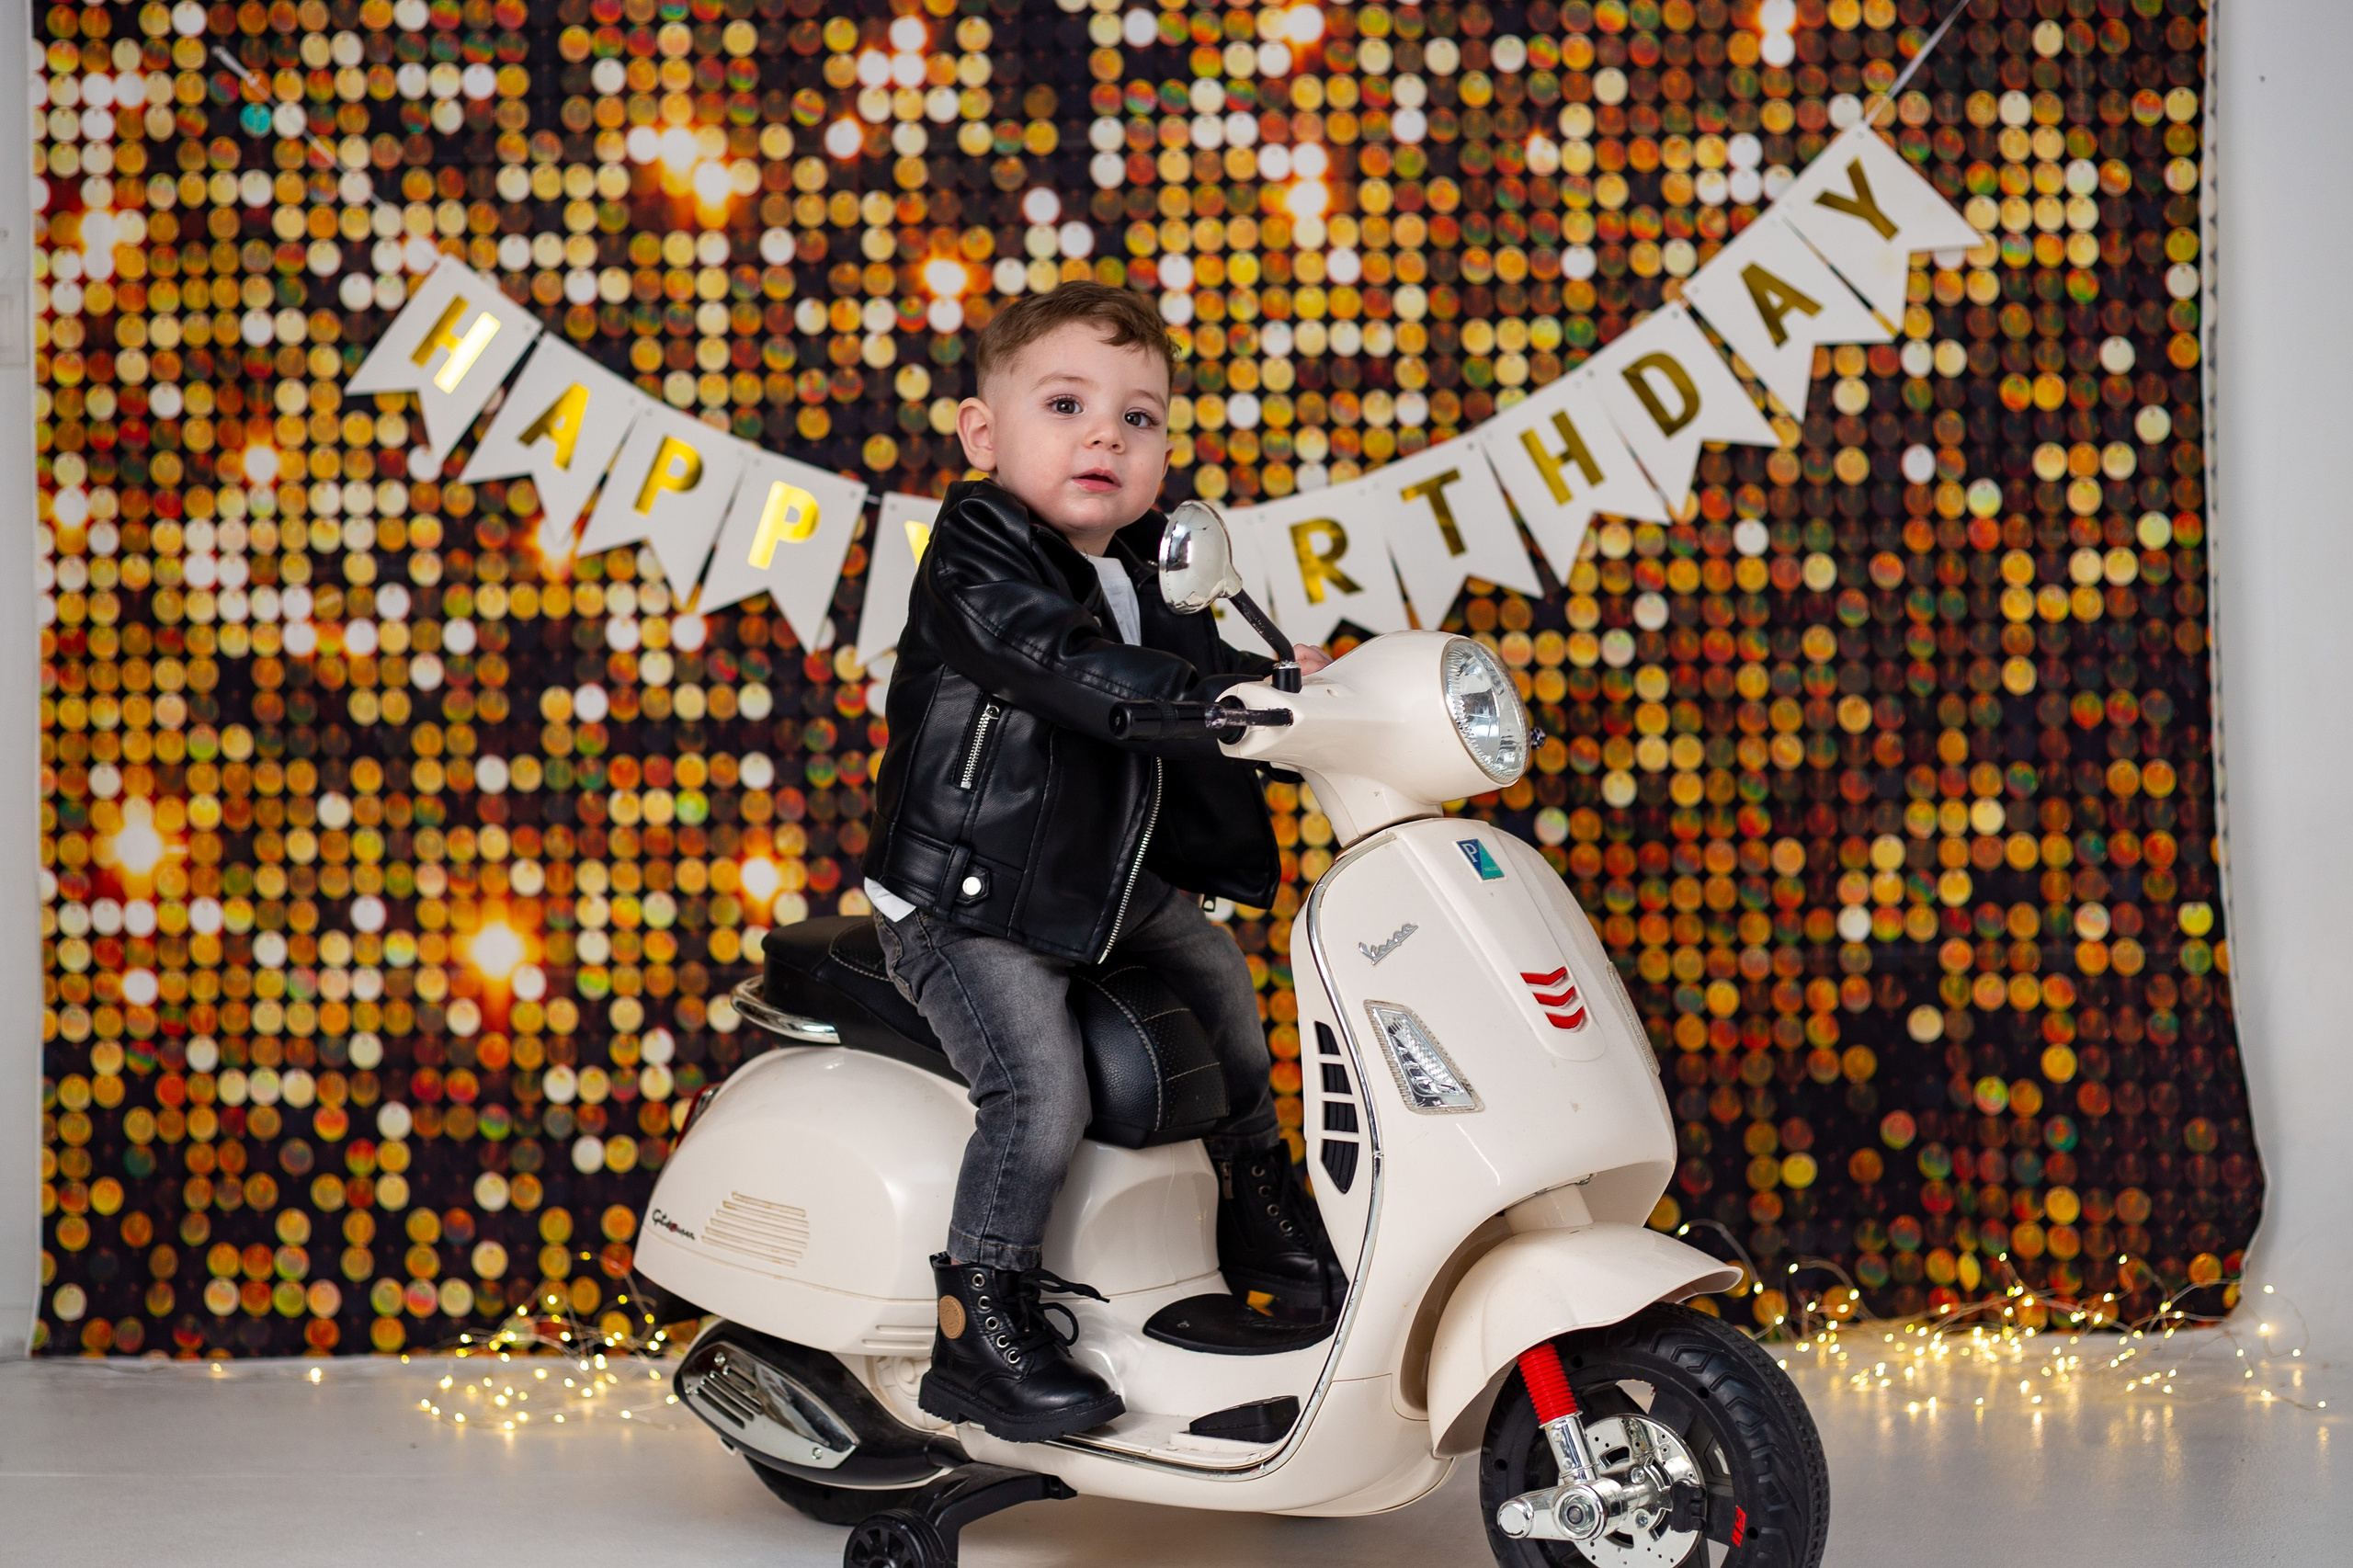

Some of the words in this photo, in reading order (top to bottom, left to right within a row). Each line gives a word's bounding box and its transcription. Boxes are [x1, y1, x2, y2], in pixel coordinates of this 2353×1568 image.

[411, 294, 930, 570] HAPP
[1210, 157, 1900, 619] RTHDAY
[1461, 843, 1479, 863] P
